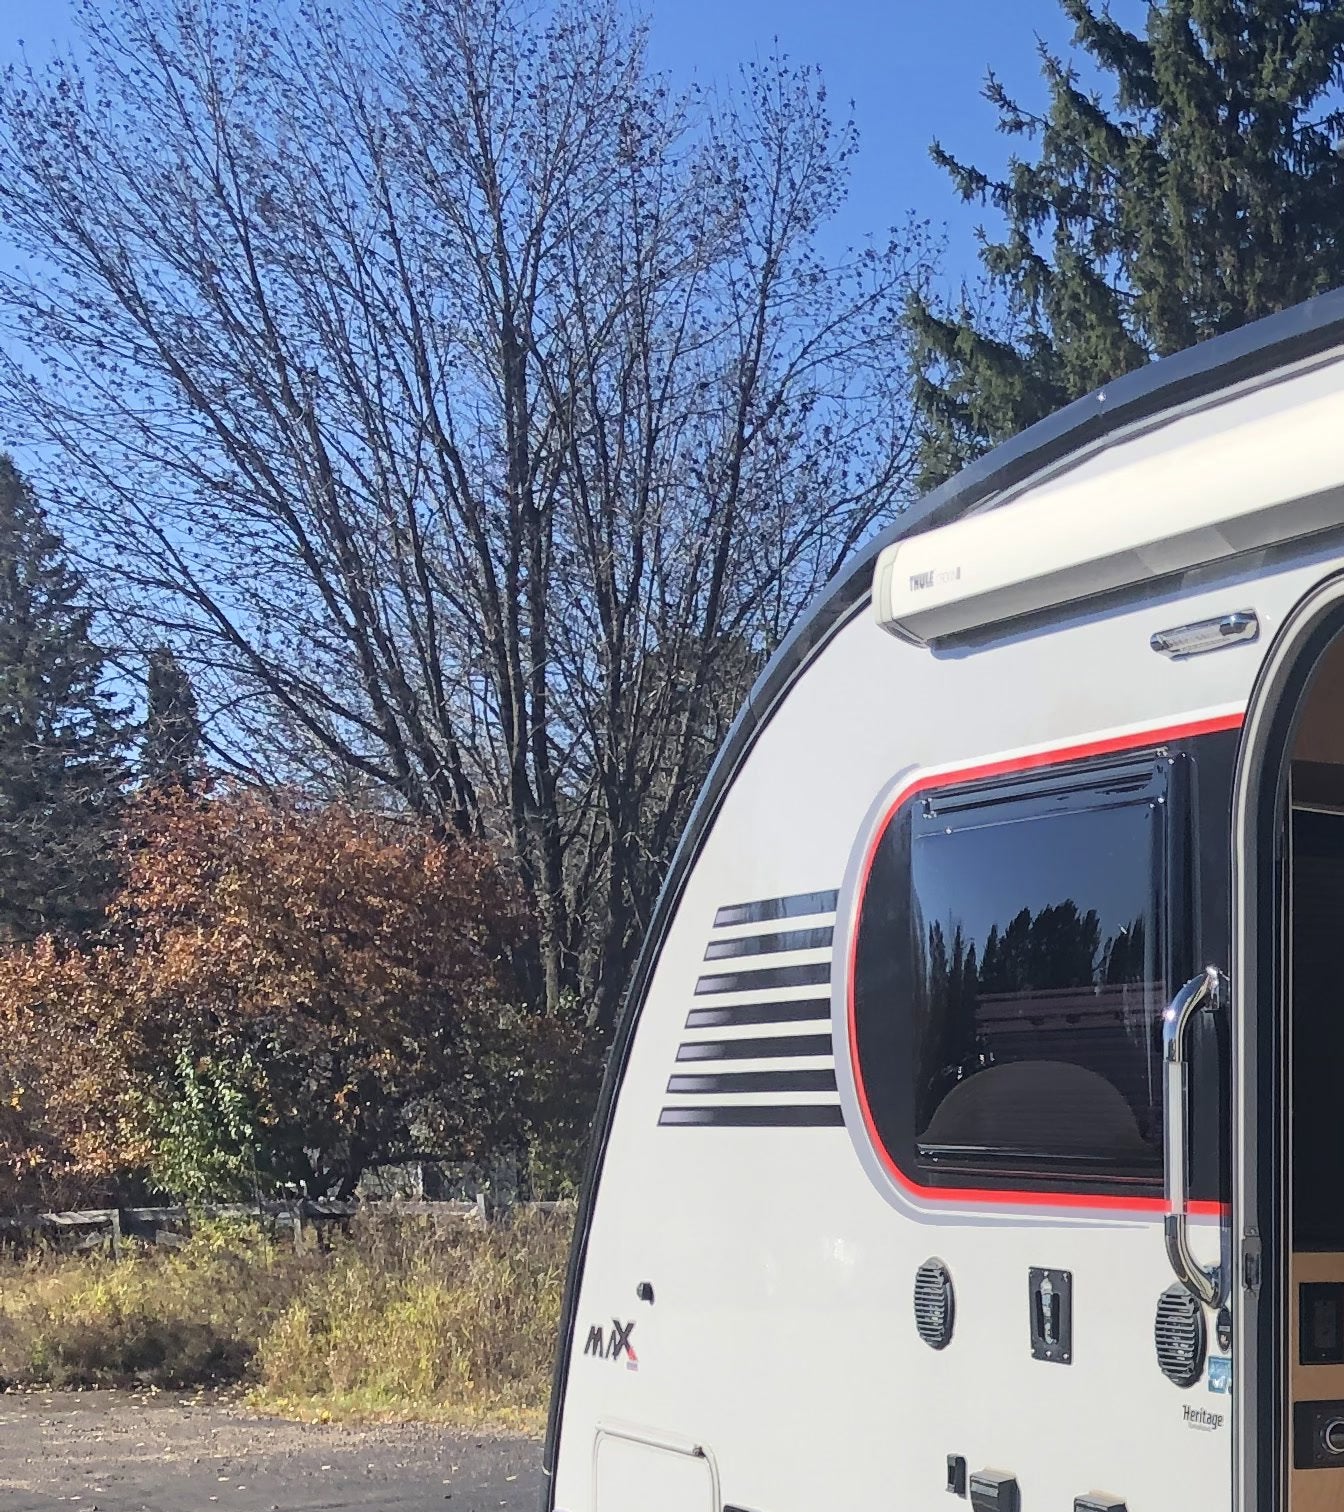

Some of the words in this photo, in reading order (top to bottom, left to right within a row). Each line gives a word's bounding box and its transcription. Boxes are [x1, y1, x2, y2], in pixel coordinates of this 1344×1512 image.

[909, 570, 934, 592] THULE
[583, 1318, 639, 1362] MAX
[1182, 1404, 1225, 1430] Heritage
